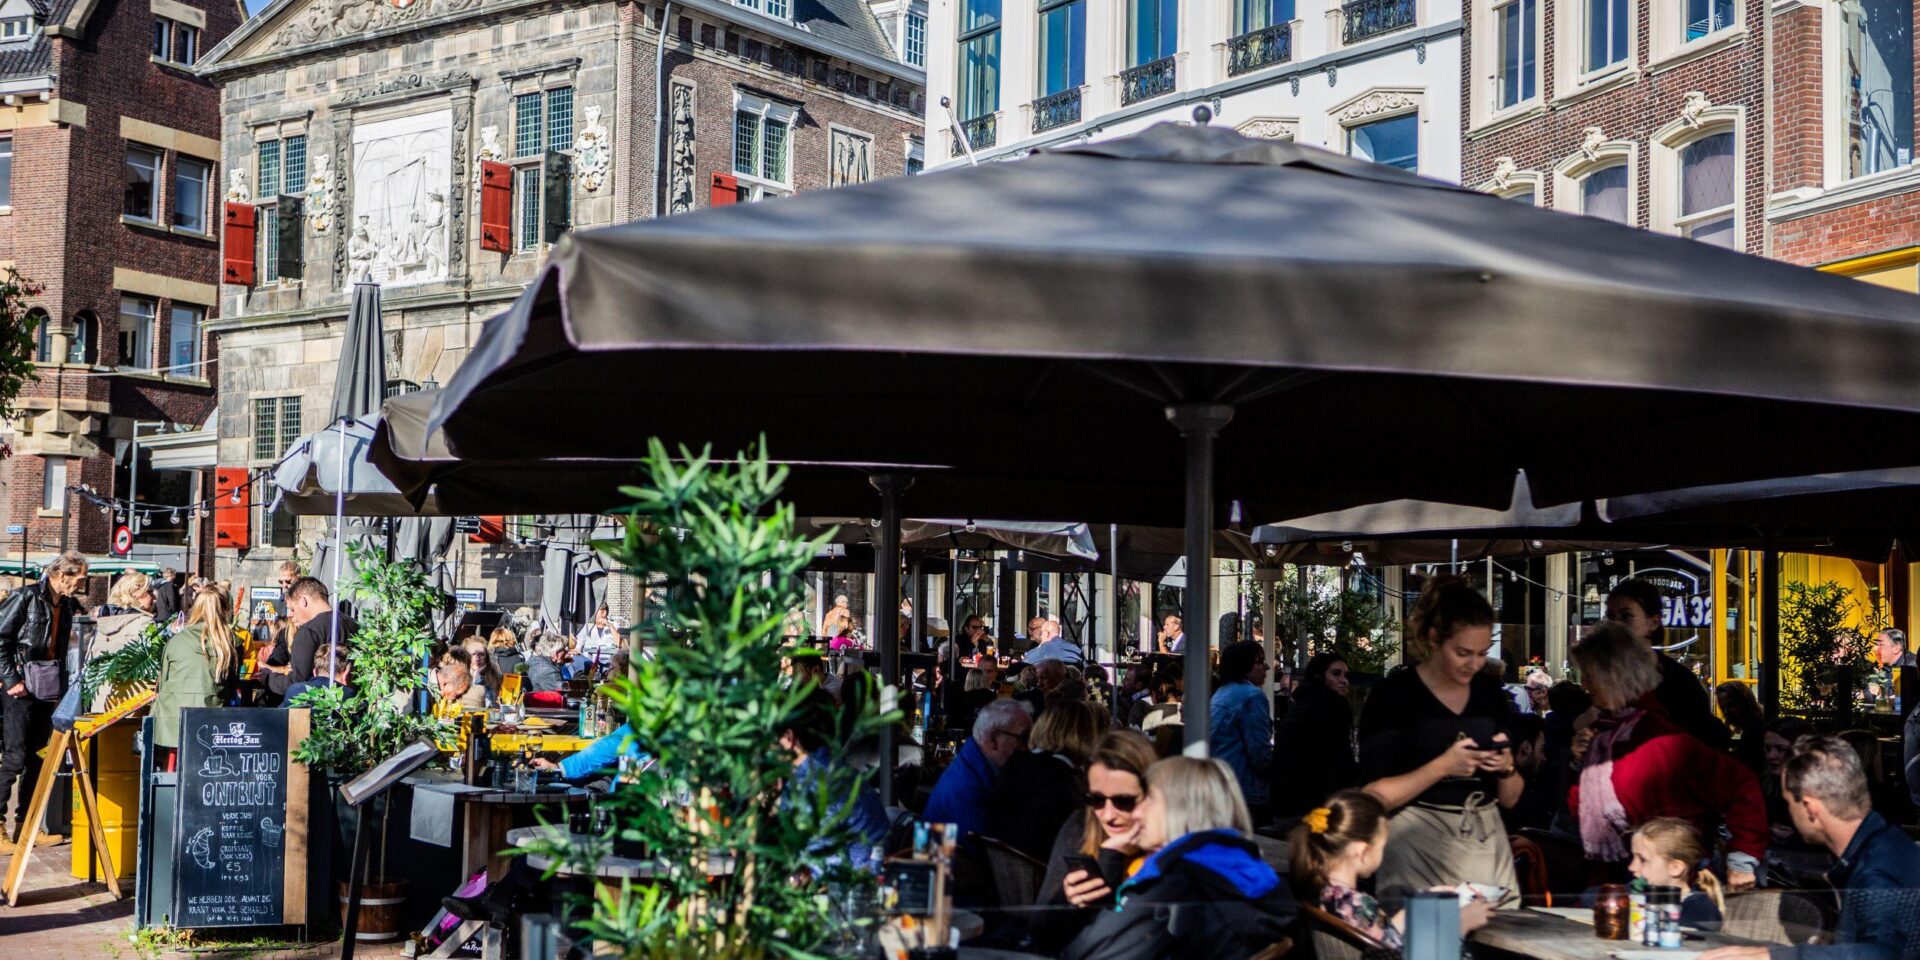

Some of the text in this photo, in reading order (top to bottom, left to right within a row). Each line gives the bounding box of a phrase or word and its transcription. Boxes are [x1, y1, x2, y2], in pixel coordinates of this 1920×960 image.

[213, 735, 260, 746] Hertog Jan
[240, 752, 280, 773] TIJD
[255, 774, 274, 782] VOOR
[202, 781, 277, 806] ONTBIJT
[222, 812, 253, 820] VERSE JUS
[220, 845, 253, 853] CROISSANT
[226, 861, 242, 872] €5
[187, 895, 198, 904] WE
[199, 895, 223, 904] HEBBEN
[224, 895, 237, 903] OOK
[261, 895, 272, 903] DE
[188, 905, 209, 914] KRANT
[211, 906, 226, 914] VOOR
